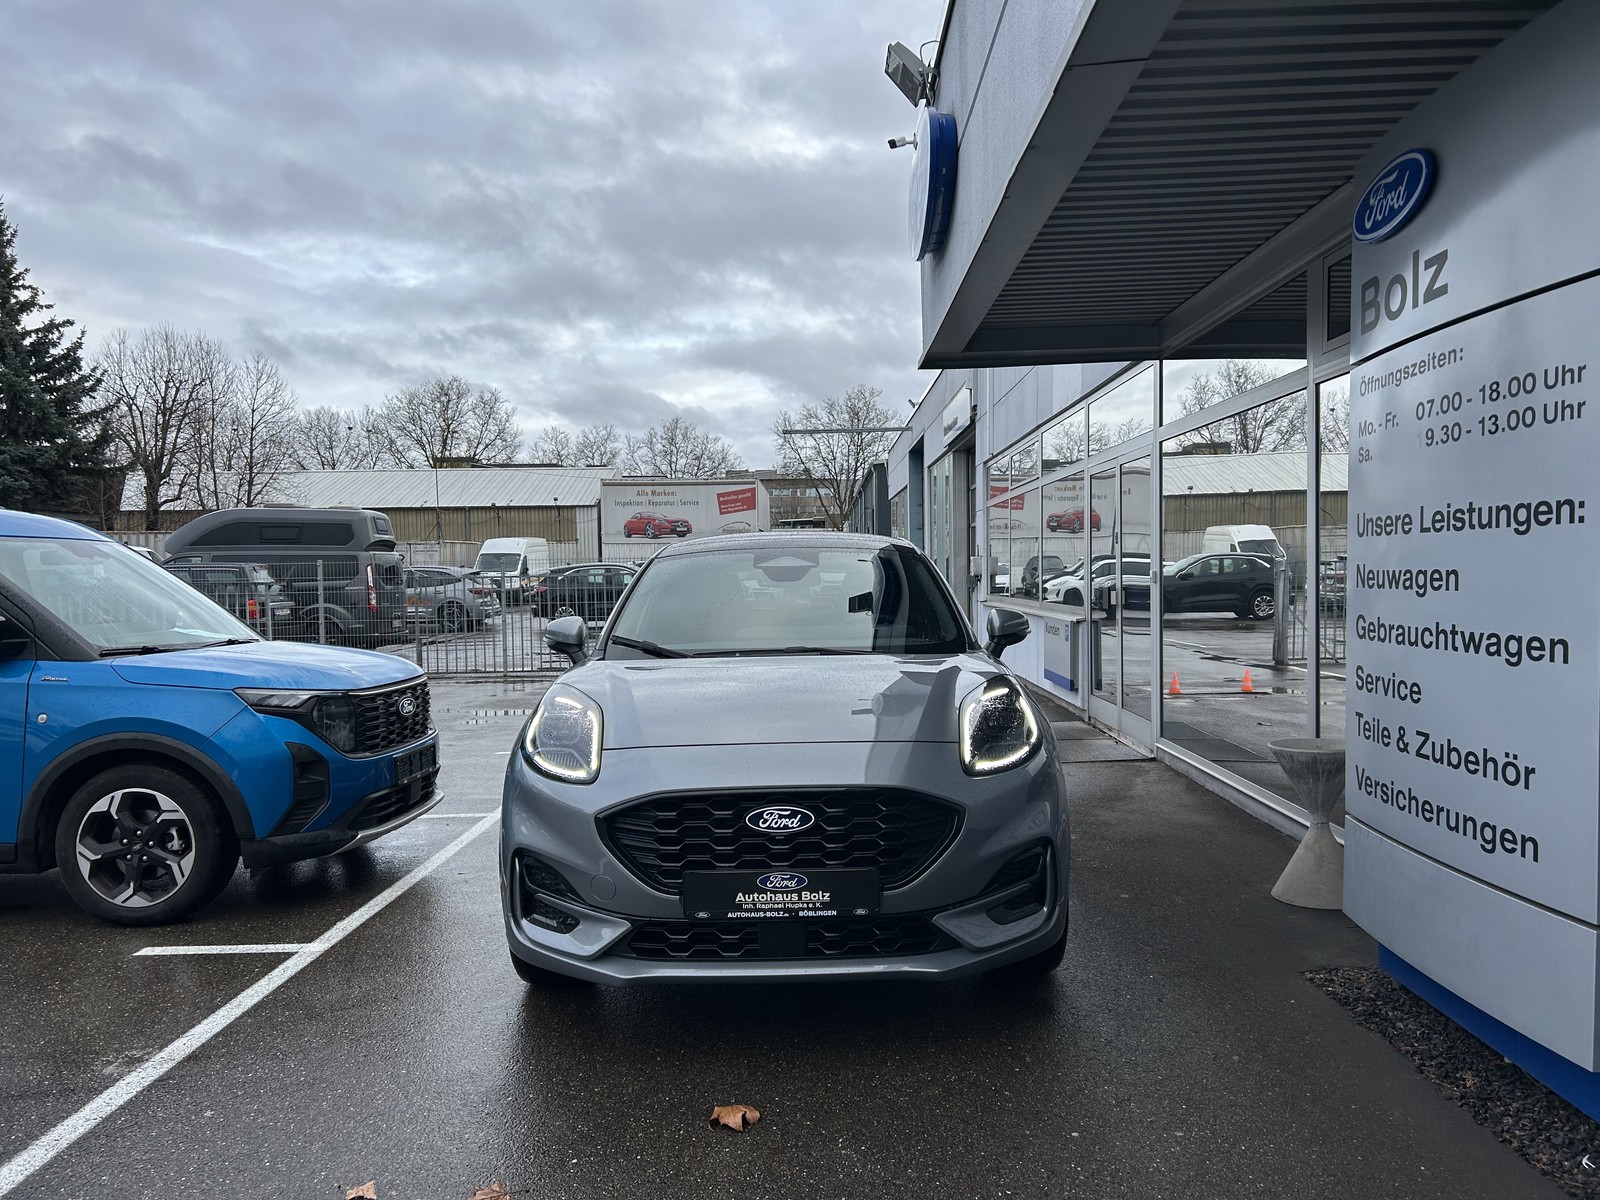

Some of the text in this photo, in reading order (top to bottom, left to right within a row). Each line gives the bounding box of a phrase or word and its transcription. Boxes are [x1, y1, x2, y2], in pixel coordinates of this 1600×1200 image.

[1365, 169, 1410, 229] Ford
[1360, 249, 1449, 337] Bolz
[1359, 347, 1464, 397] Öffnungszeiten:
[1543, 364, 1587, 390] Uhr
[1358, 446, 1373, 465] Sa.
[1543, 399, 1586, 425] Uhr
[614, 498, 700, 508] Inspektion Reparatur Service
[637, 489, 677, 497] Alle Marken:
[1356, 498, 1586, 538] Unsere Leistungen:
[1355, 563, 1460, 598] Neuwagen
[1355, 614, 1570, 667] Gebrauchtwagen
[1355, 665, 1422, 704] Service
[1355, 711, 1536, 791] Teile & Zubehör
[759, 809, 801, 828] Ford
[1355, 764, 1540, 863] Versicherungen
[735, 891, 831, 902] Autohaus Bolz
[766, 874, 798, 888] Ford
